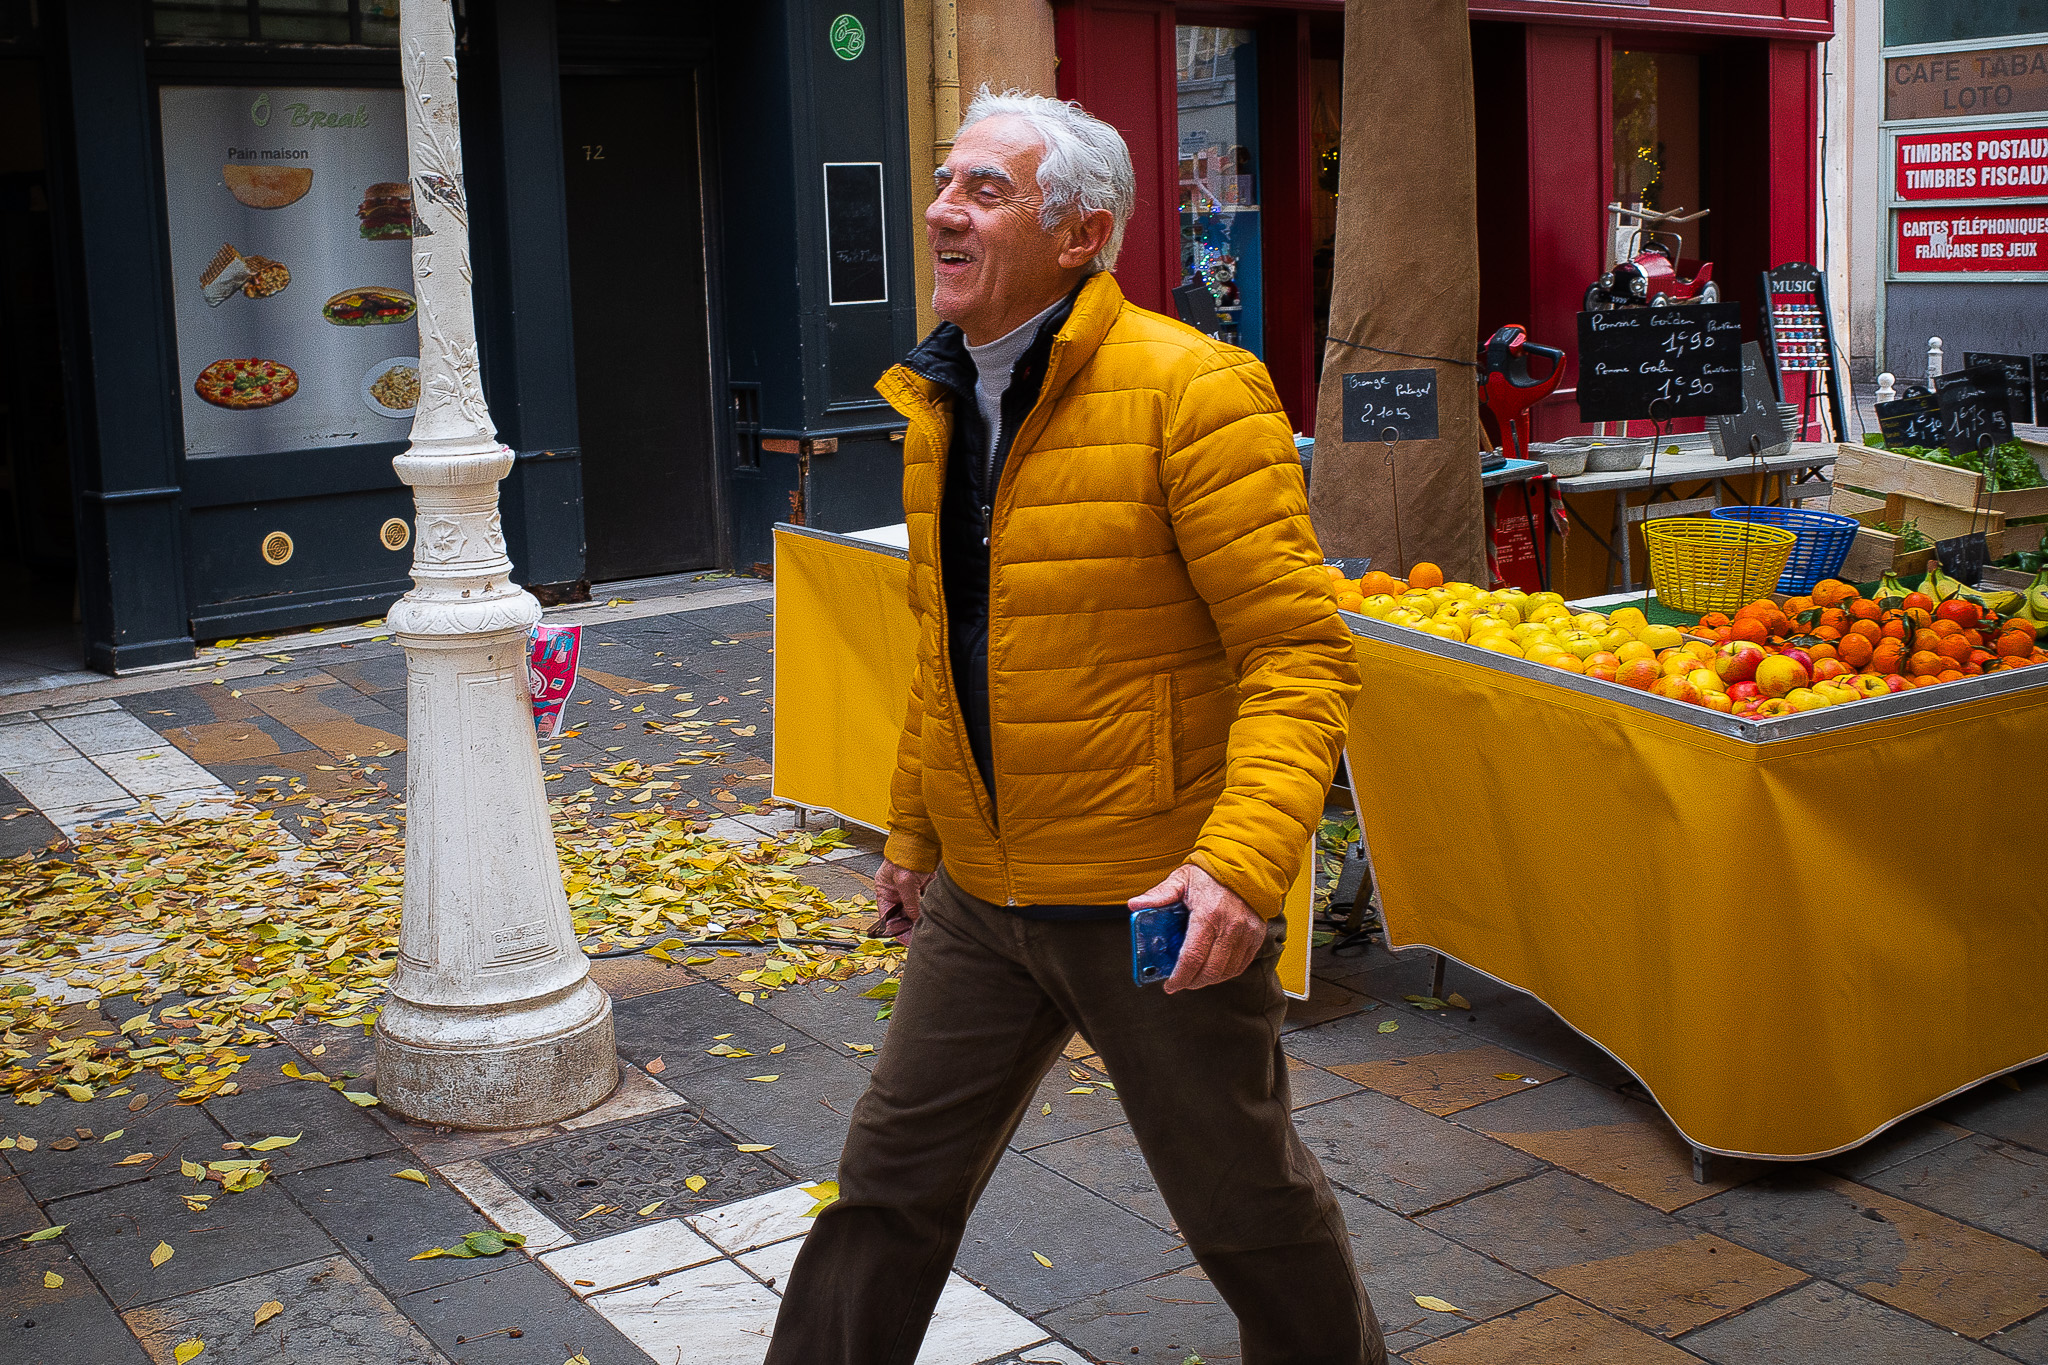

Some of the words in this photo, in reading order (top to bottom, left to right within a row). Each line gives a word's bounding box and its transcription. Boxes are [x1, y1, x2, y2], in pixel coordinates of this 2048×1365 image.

[1895, 59, 1960, 84] CAFE
[1944, 85, 2013, 110] LOTO
[283, 102, 369, 130] Break
[228, 148, 257, 160] Pain
[260, 148, 309, 159] maison
[582, 145, 605, 160] 72
[1902, 142, 1973, 164] TIMBRES
[1905, 168, 1976, 189] TIMBRES
[1903, 221, 1949, 237] CARTES
[1915, 243, 1979, 260] FRANÇAISE
[1981, 244, 2004, 258] DES
[2006, 242, 2037, 258] JEUX
[1772, 280, 1816, 292] MUSIC
